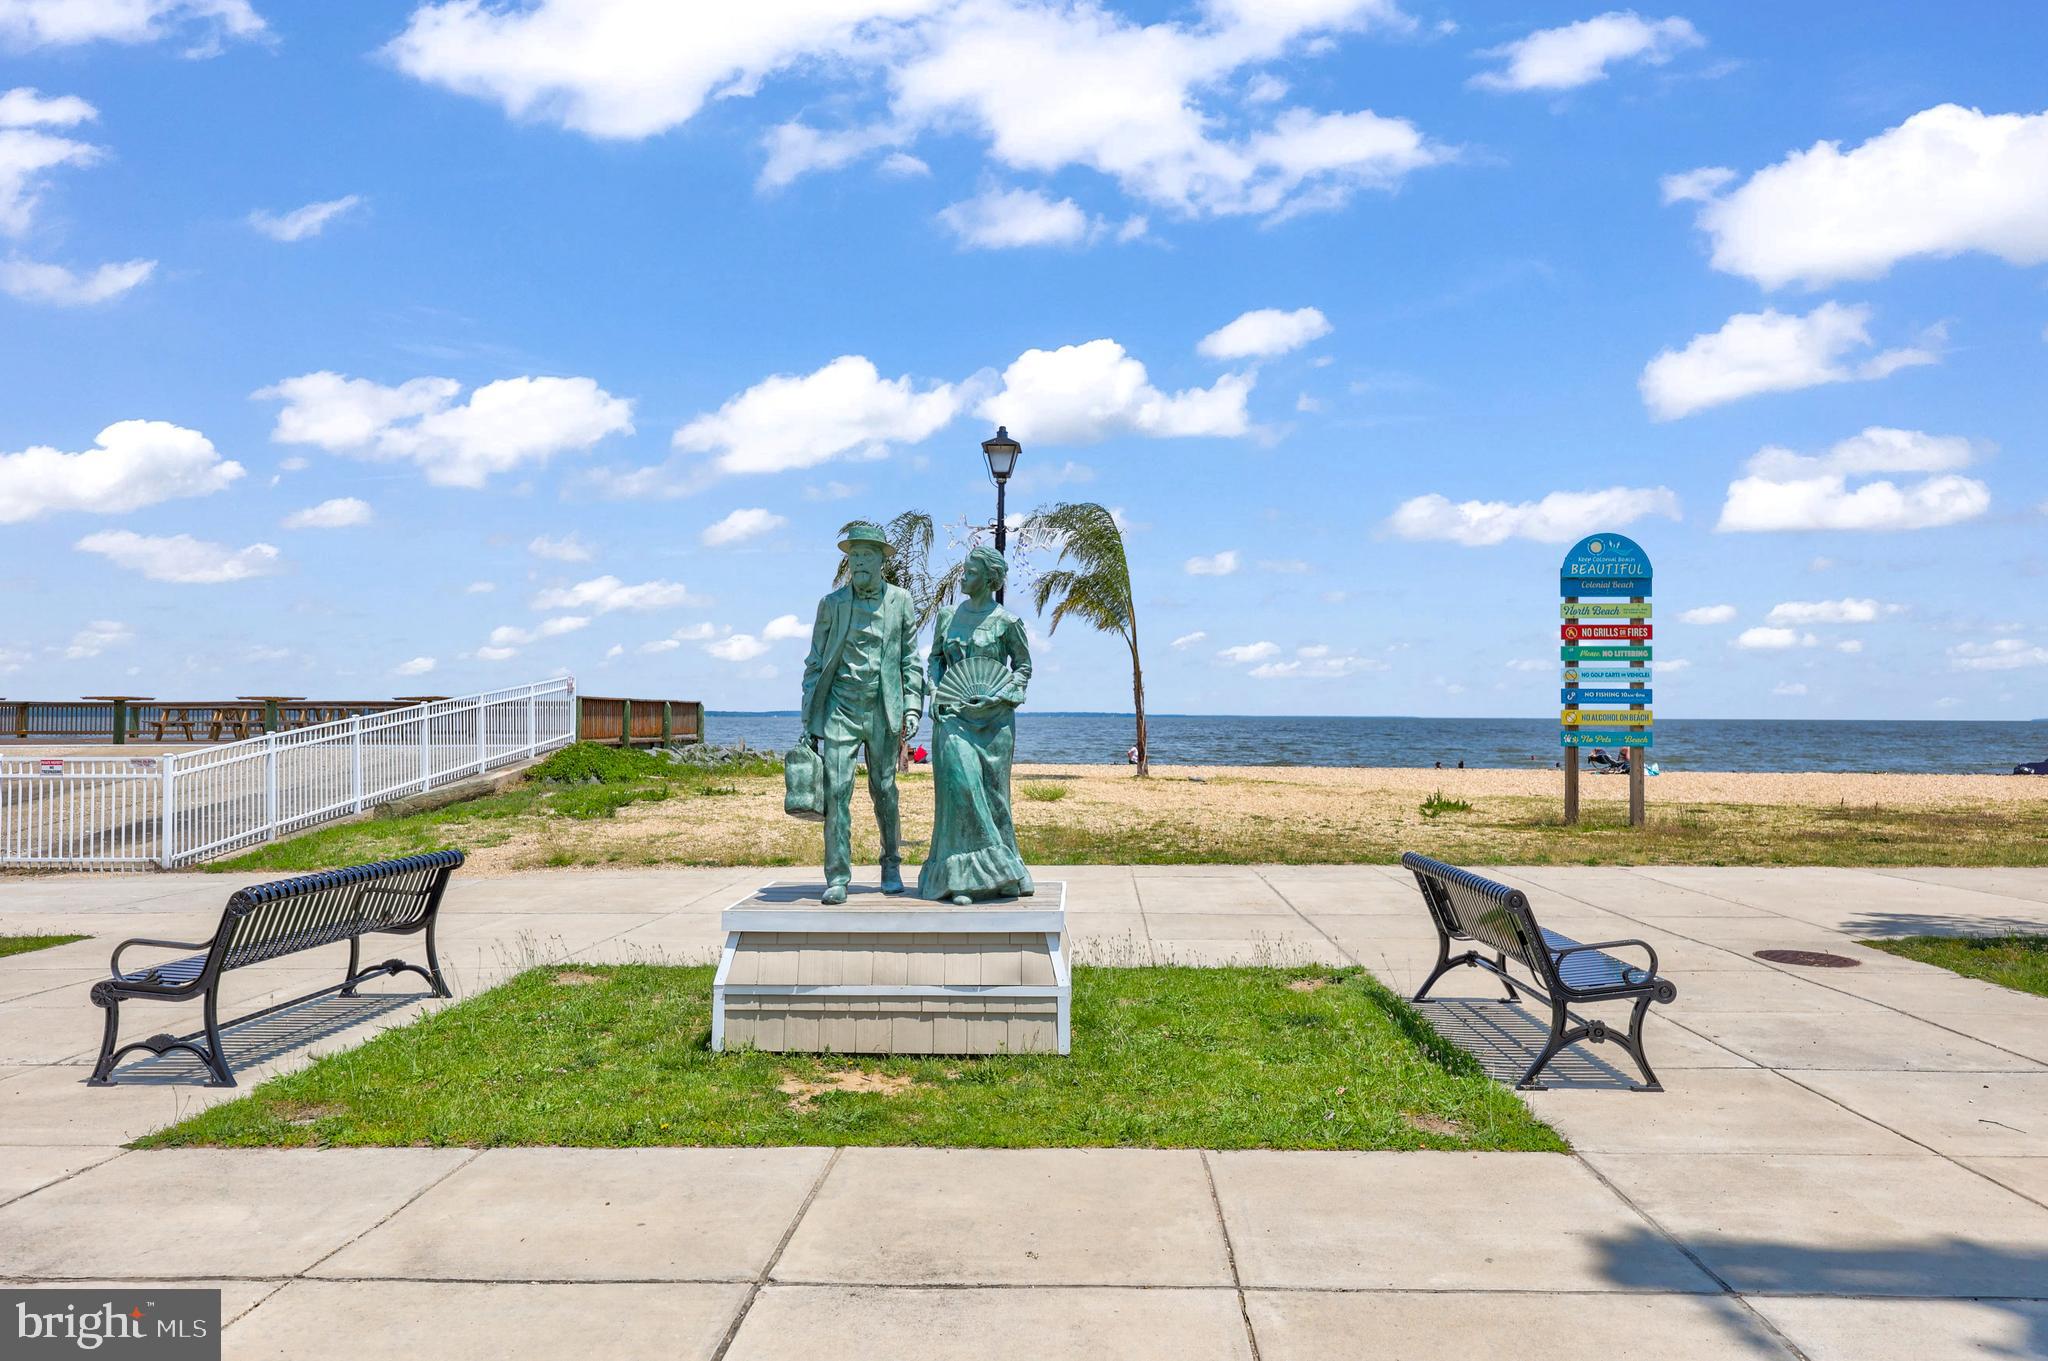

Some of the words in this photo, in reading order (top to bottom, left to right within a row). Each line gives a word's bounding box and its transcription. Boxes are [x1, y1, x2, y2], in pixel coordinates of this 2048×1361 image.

[1571, 563, 1644, 575] BEAUTIFUL
[1581, 580, 1611, 589] Colonial
[1612, 580, 1634, 589] Beach
[1563, 605, 1590, 615] North
[1592, 605, 1620, 615] Beach
[1582, 627, 1591, 637] NO
[1593, 627, 1619, 637] GRILLS
[1627, 627, 1648, 637] FIRES
[1581, 714, 1591, 722] NO
[1591, 714, 1619, 722] ALCOHOL
[1620, 714, 1629, 722] ON
[1630, 714, 1649, 722] BEACH
[1580, 735, 1593, 743] No
[1594, 735, 1611, 743] Pets
[1624, 735, 1648, 743] Beach
